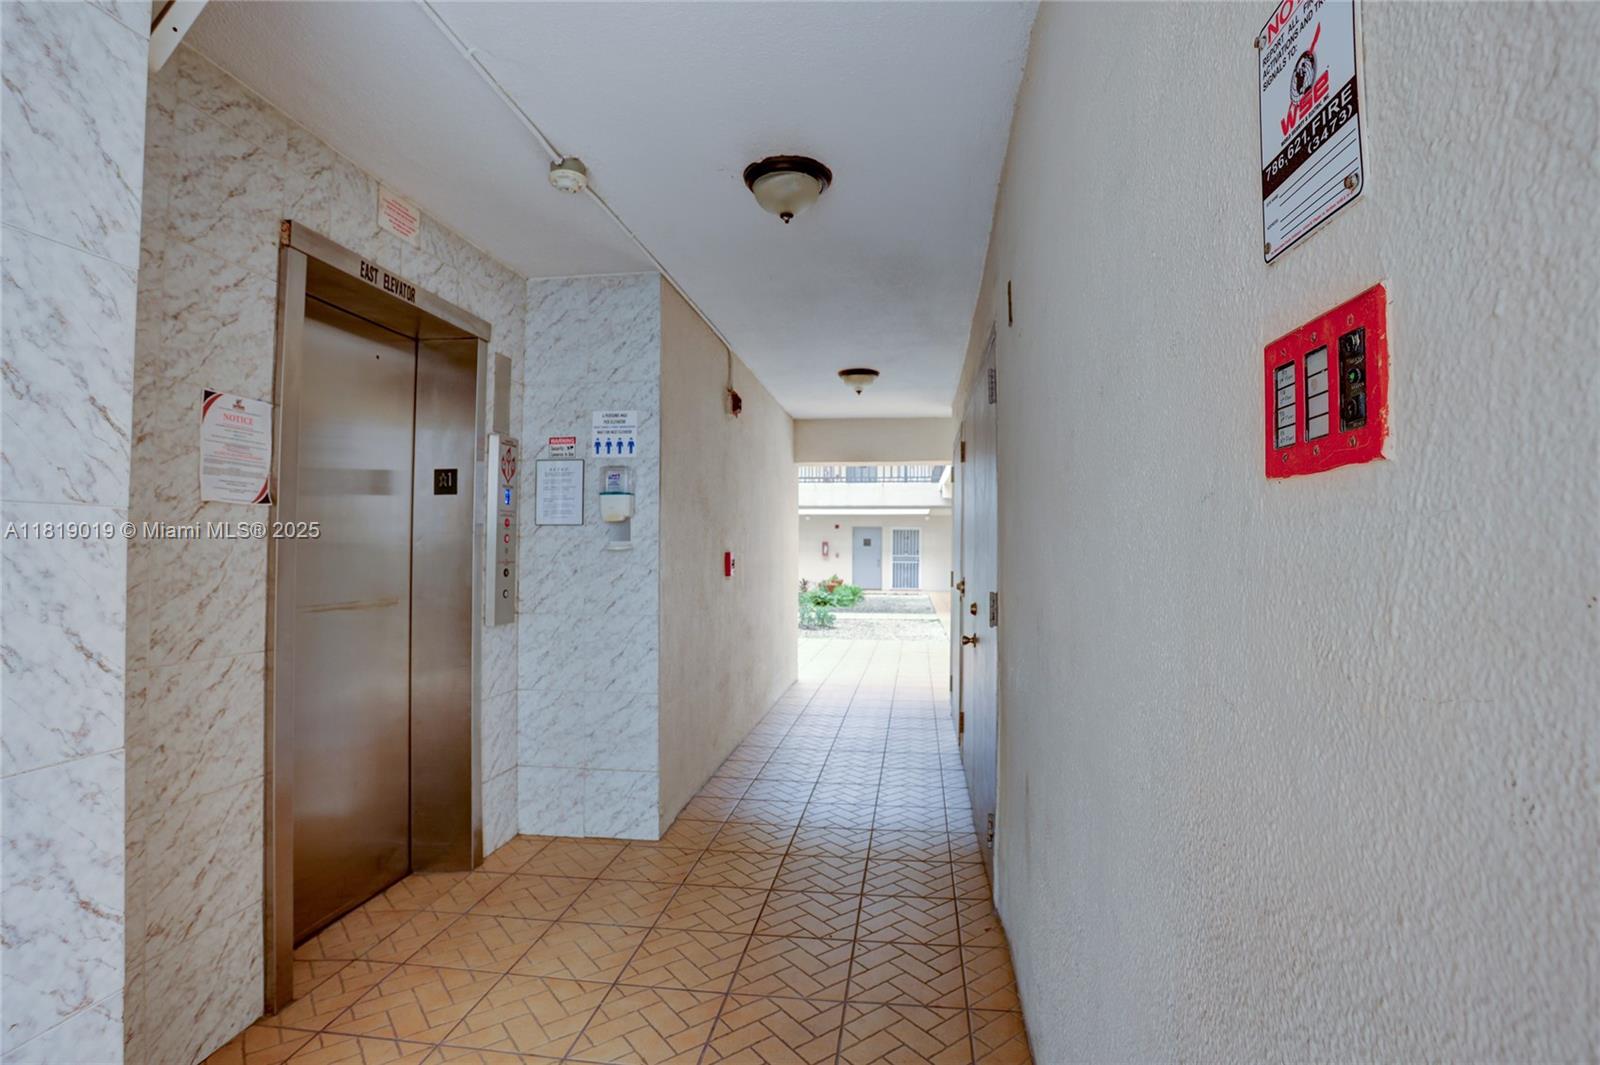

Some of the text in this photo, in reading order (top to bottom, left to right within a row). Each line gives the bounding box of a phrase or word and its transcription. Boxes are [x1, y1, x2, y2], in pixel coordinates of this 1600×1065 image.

[1262, 32, 1285, 67] REPORT
[1288, 15, 1300, 34] ALL
[1262, 29, 1299, 80] ACTIVATIONS
[1300, 10, 1314, 33] AND
[1262, 44, 1298, 91] SIGNALS TO:
[1308, 104, 1353, 154] (3473)
[360, 260, 416, 304] EAST ELEVATOR
[223, 413, 254, 426] NOTICE
